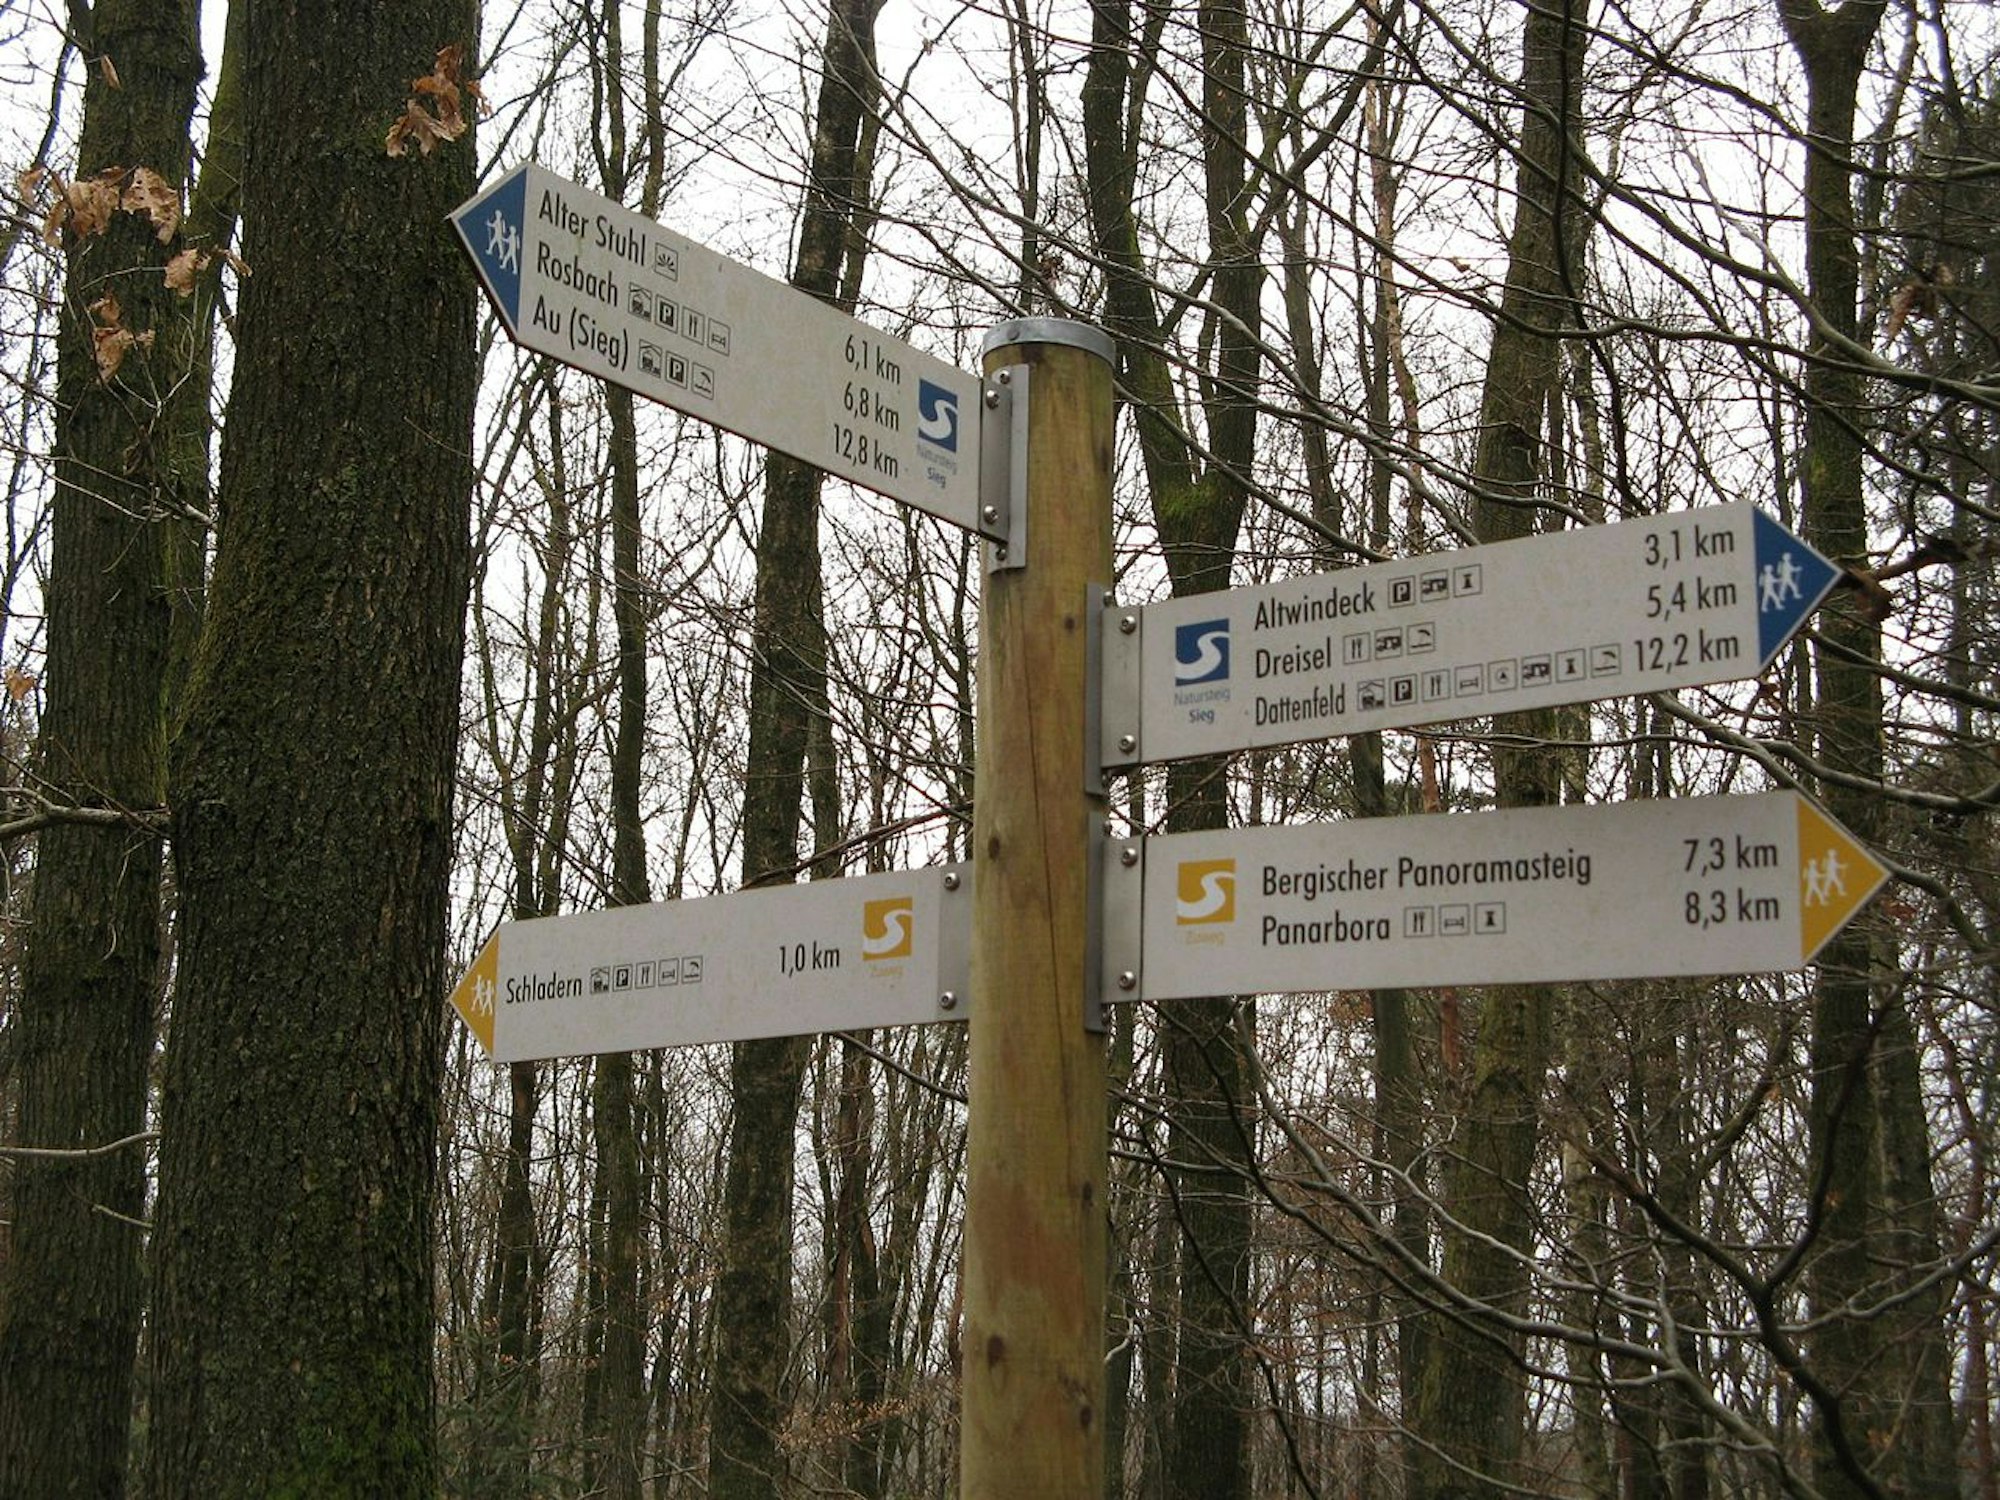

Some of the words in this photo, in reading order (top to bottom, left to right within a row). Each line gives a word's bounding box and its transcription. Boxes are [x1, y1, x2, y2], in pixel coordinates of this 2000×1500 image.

[539, 190, 589, 238] Alter
[595, 215, 646, 266] Stuhl
[537, 241, 619, 307] Rosbach
[533, 295, 560, 335] Au
[569, 307, 628, 372] (Sieg)
[845, 334, 868, 372] 6,1
[876, 346, 900, 385] km
[844, 381, 869, 419] 6,8
[875, 393, 899, 431] km
[834, 424, 868, 467] 12,8
[874, 440, 898, 478] km
[1644, 530, 1680, 570] 3,1
[1694, 525, 1734, 557] km
[1254, 581, 1375, 630] Altwindeck
[1646, 582, 1686, 622] 5,4
[1696, 577, 1737, 610] km
[1256, 637, 1331, 678] Dreisel
[1634, 633, 1688, 674] 12,2
[1699, 629, 1739, 662] km
[1189, 709, 1215, 725] Sieg
[1256, 683, 1345, 726] Dattenfeld
[1262, 859, 1388, 900] Bergischer
[1398, 849, 1591, 887] Panoramasteig
[1683, 838, 1724, 877] 7,3
[1737, 835, 1778, 869] km
[1262, 905, 1390, 946] Panarbora
[1685, 890, 1726, 930] 8,3
[1738, 888, 1779, 922] km
[779, 943, 805, 978] 1,0
[812, 940, 840, 970] km
[507, 972, 581, 1004] Schladern
